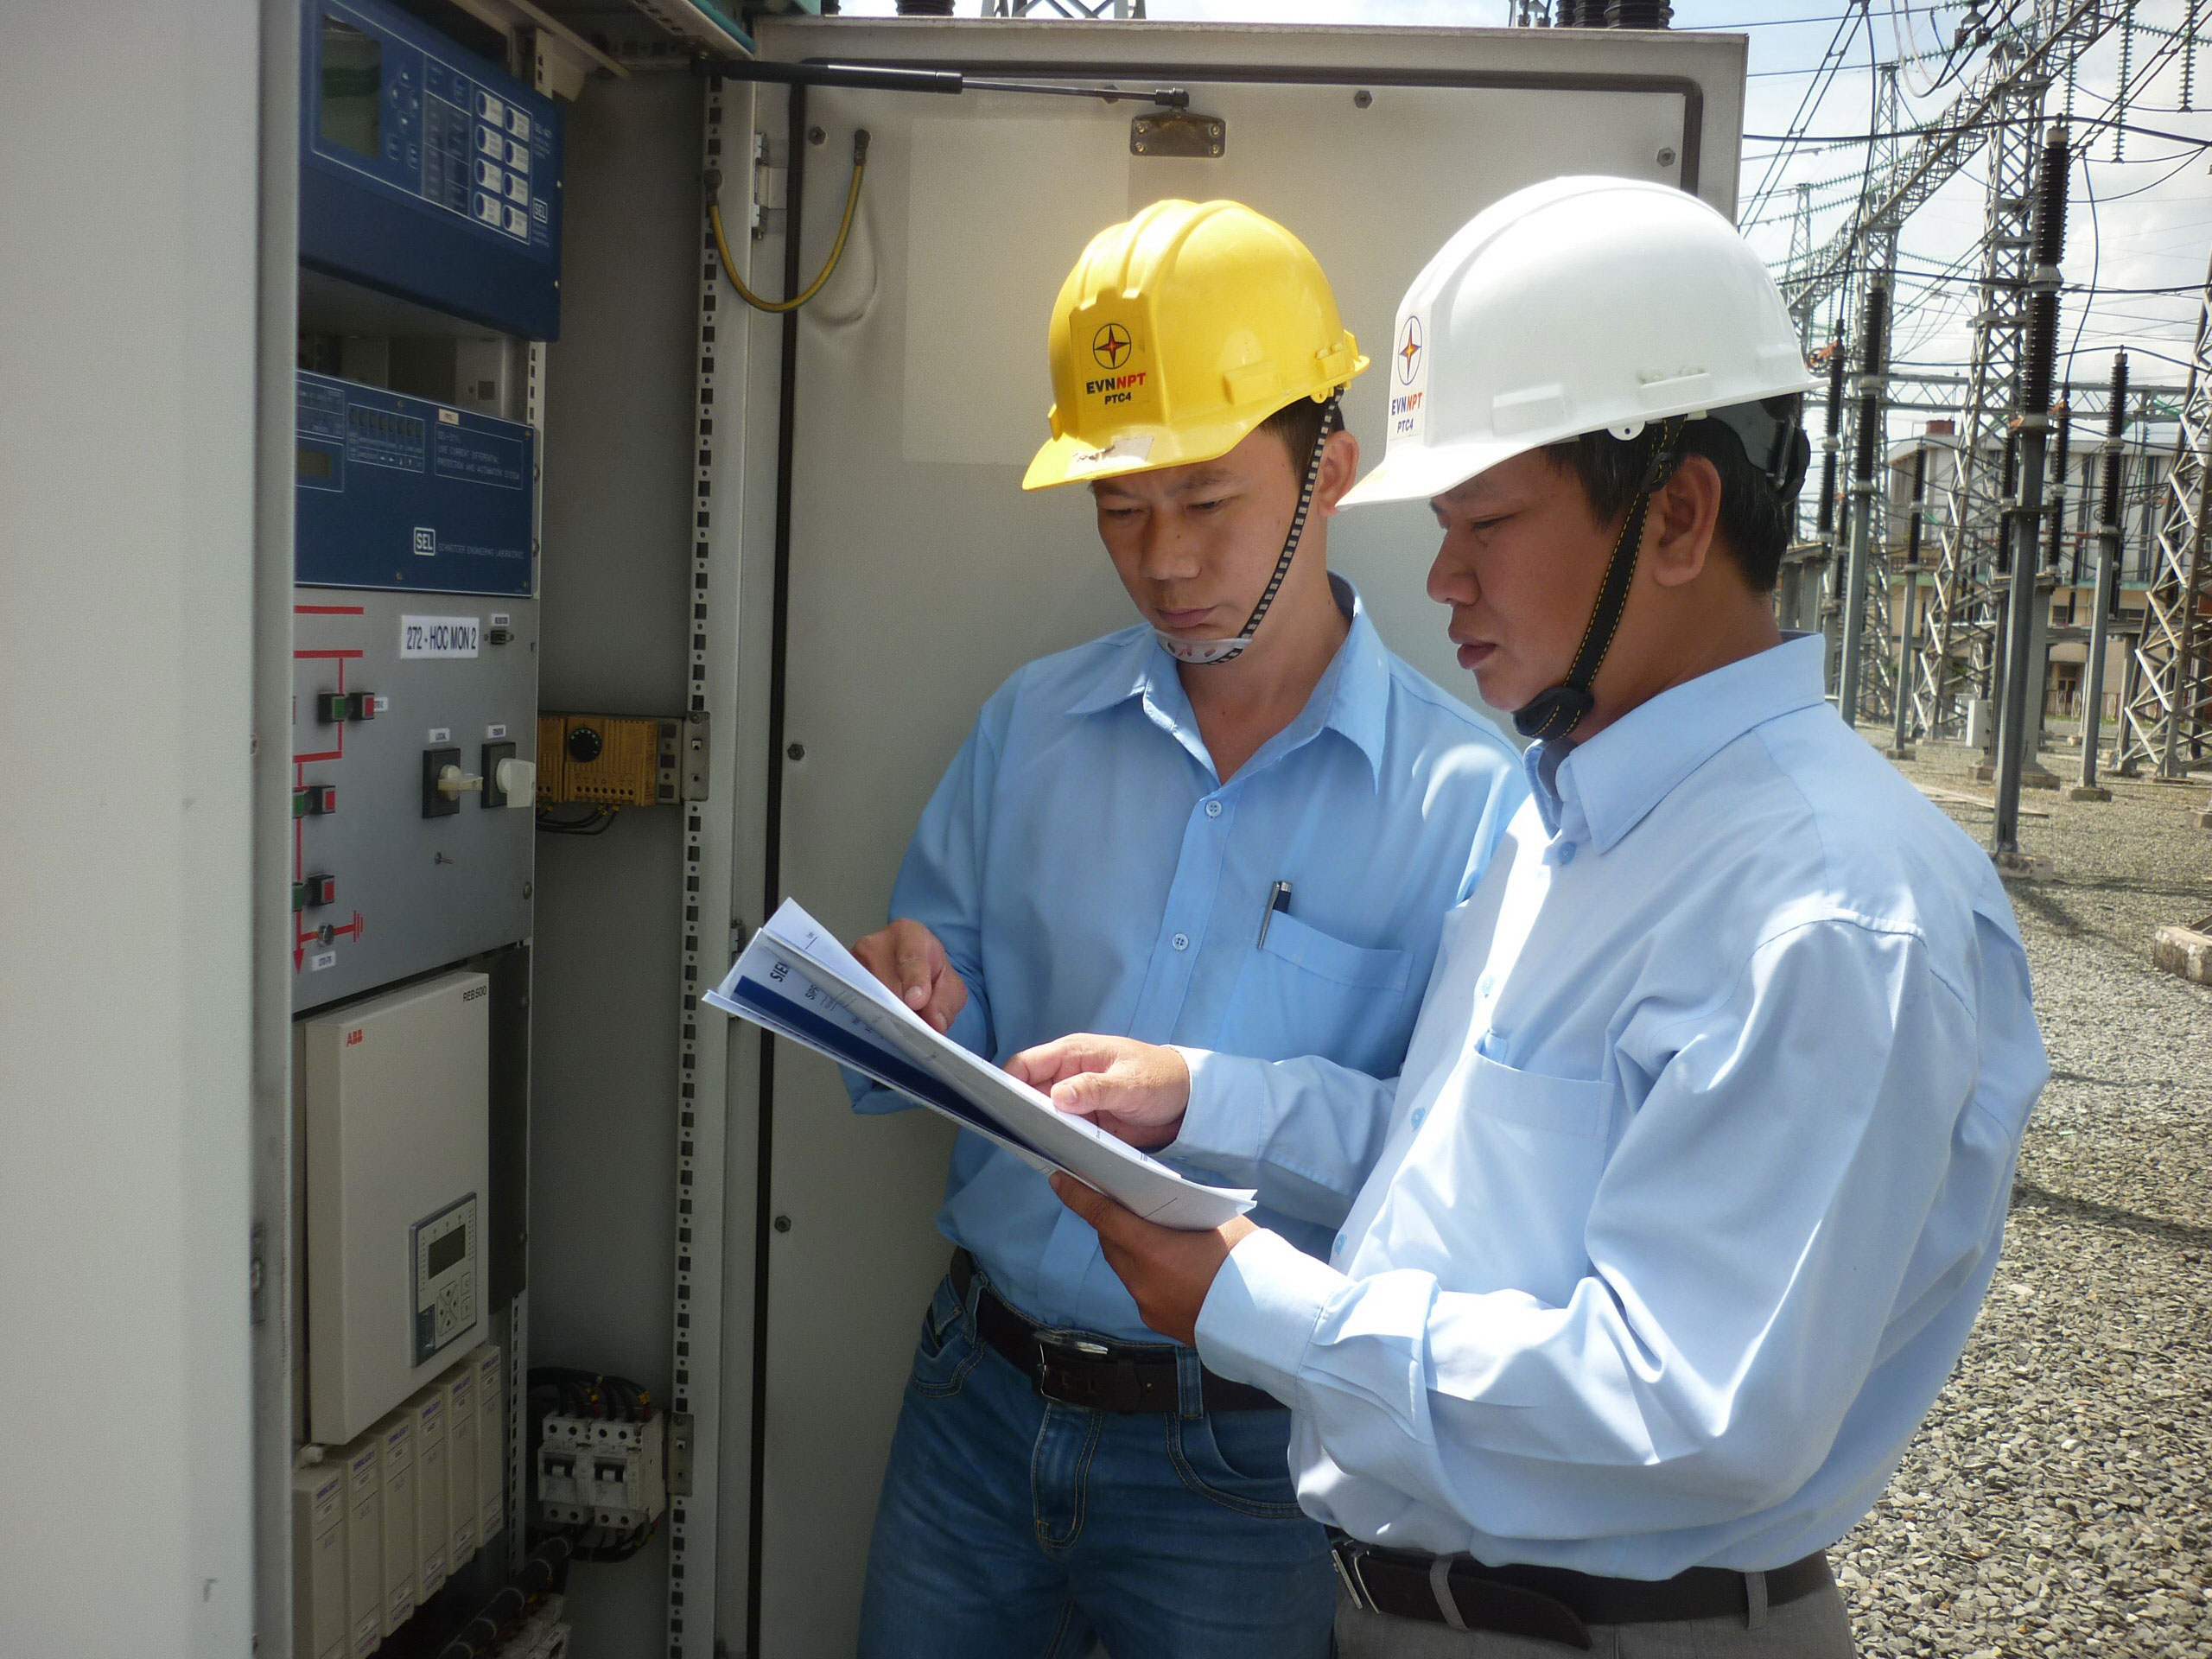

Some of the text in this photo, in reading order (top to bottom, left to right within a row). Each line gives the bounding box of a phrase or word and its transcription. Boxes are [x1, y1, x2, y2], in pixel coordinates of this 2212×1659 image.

[1086, 372, 1146, 394] EVNNPT
[1104, 392, 1132, 405] PTC4
[1391, 392, 1422, 416] EVNNPT
[1397, 418, 1414, 434] PTC4
[416, 532, 433, 550] SEL
[406, 626, 423, 650] 272
[429, 626, 449, 650] HOC
[450, 626, 470, 650] MON
[471, 626, 477, 650] 2
[346, 1029, 363, 1047] ABB
